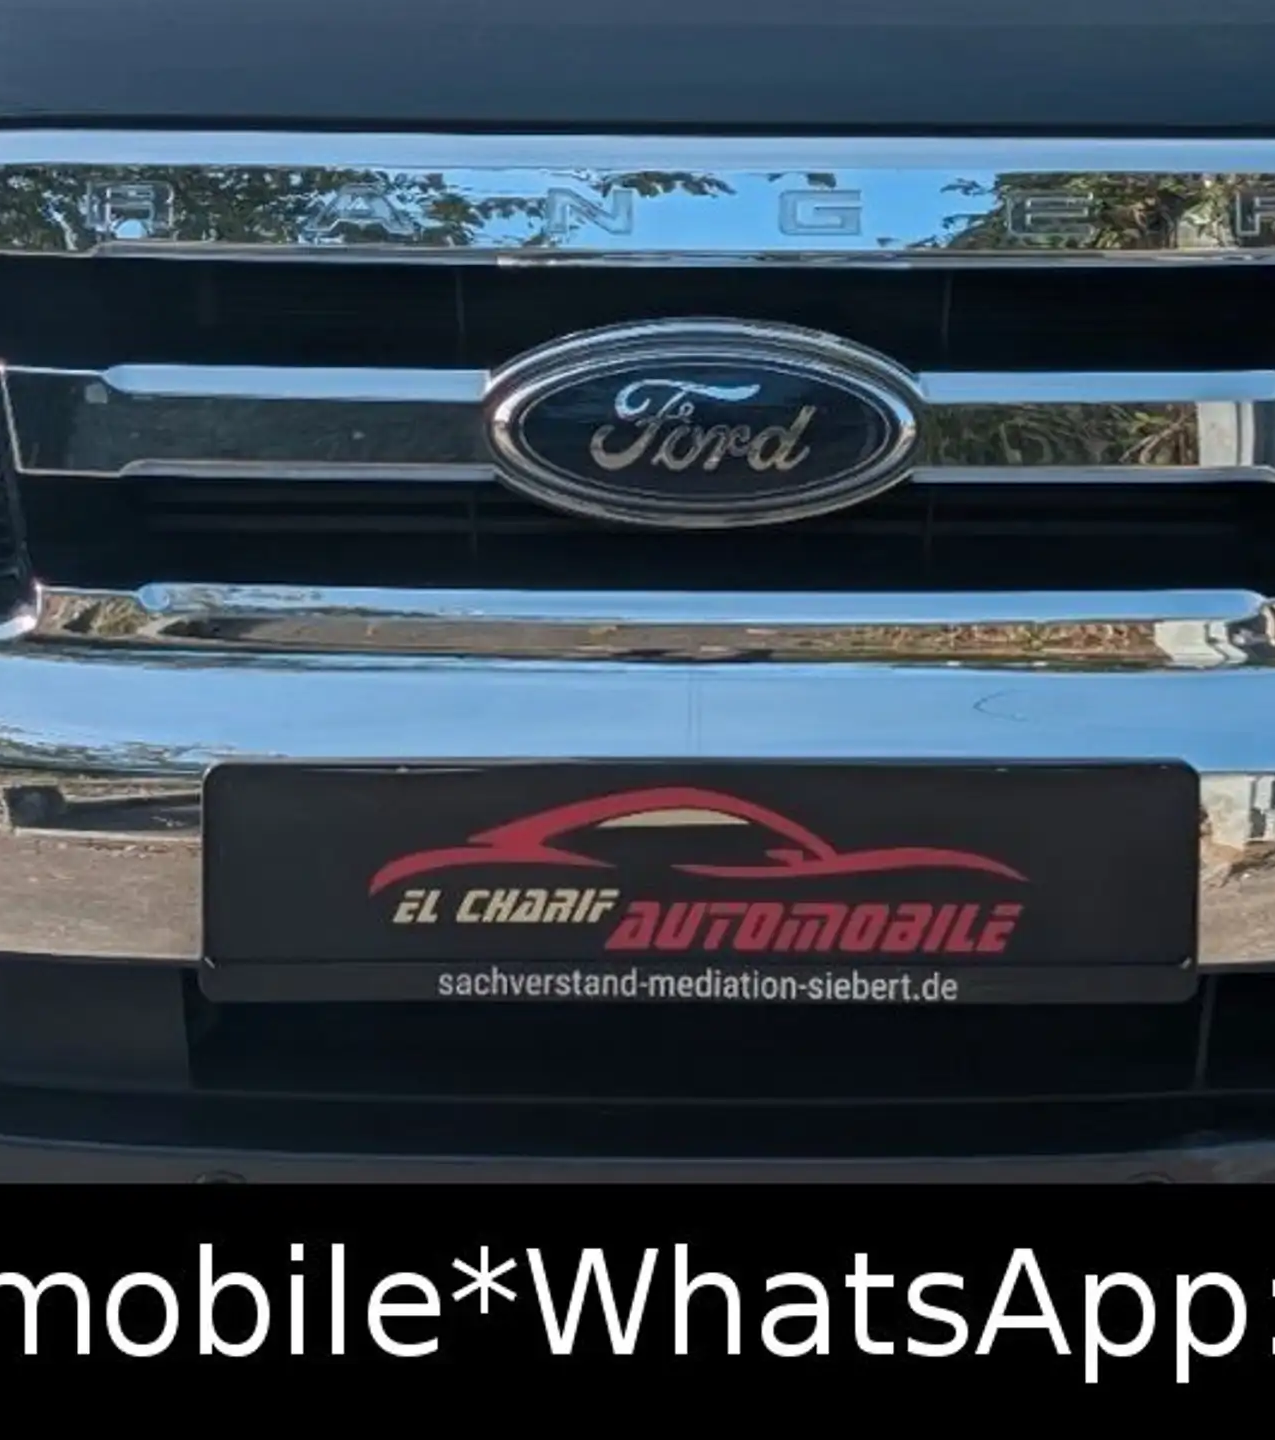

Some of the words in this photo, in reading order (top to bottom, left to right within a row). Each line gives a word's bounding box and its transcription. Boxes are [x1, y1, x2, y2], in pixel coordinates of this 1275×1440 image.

[589, 378, 817, 471] Ford
[392, 888, 443, 924] EL
[455, 887, 620, 924] CHARIF
[604, 900, 1023, 954] AUTOMOBILE
[438, 966, 959, 1001] sachverstand-mediation-siebert.de
